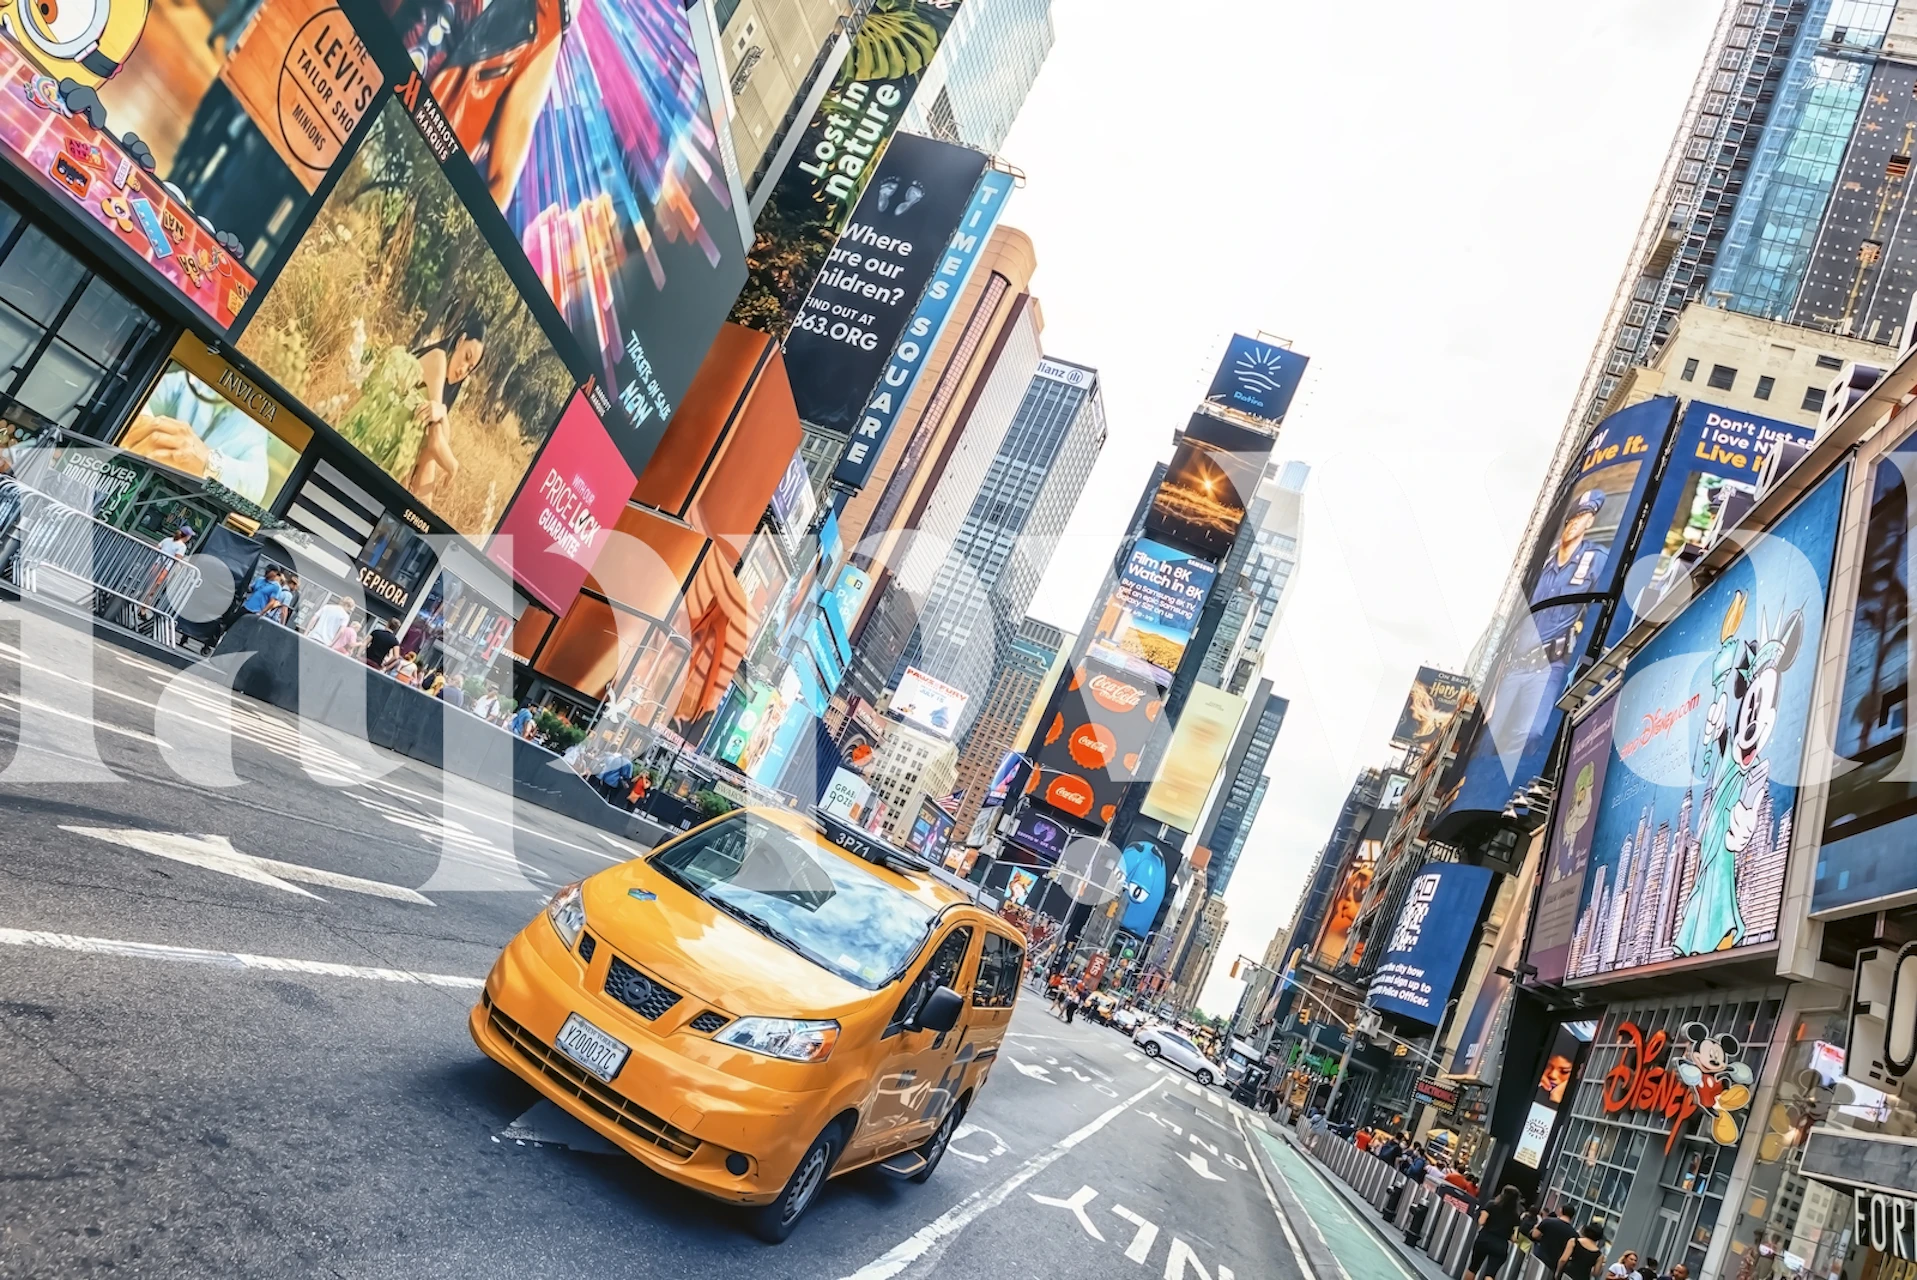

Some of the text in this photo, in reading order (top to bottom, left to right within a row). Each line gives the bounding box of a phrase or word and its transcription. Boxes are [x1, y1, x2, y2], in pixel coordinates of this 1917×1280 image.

[349, 32, 371, 66] THE
[297, 48, 333, 104] TAILOR
[314, 24, 372, 112] LEVI'S
[291, 104, 326, 152] MINIONS
[416, 111, 449, 161] MARQUIS
[423, 98, 460, 155] MARRIOTT
[798, 82, 870, 179] Lost in
[825, 84, 901, 201] nature
[841, 222, 913, 257] Where
[927, 185, 999, 300] TIMES
[828, 247, 905, 279] are our
[805, 296, 876, 326] FIND OUT AT
[625, 329, 671, 421] TICKETS ON SALE
[846, 317, 932, 465] SQUARE
[217, 368, 279, 423] INVICTA
[618, 379, 654, 429] NOW
[1701, 427, 1709, 439] I
[1711, 429, 1750, 449] love
[1706, 413, 1756, 436] Don't
[1756, 426, 1793, 442] just
[69, 453, 137, 483] DISCOVER
[1581, 435, 1649, 473] Live it.
[1695, 441, 1747, 468] Live
[403, 508, 430, 534] SEPHORA
[539, 468, 602, 548] PRICE LOCK
[538, 508, 580, 559] GUARANTEE
[1128, 563, 1205, 601] Watch in 8K
[1132, 551, 1193, 582] Film in 8K
[1187, 559, 1215, 574] SAMSUNG
[356, 567, 410, 608] SEPHORA
[1121, 578, 1137, 589] Buy
[1141, 585, 1176, 604] Samsung
[1159, 600, 1193, 620] Samsung
[907, 669, 967, 701] PAWS FURY
[1089, 674, 1146, 706] Coca-Cola
[1429, 681, 1459, 699] Harry
[1438, 672, 1450, 680] ON
[1078, 736, 1108, 754] Coca-Cola
[1055, 787, 1086, 805] Coca-Cola
[836, 832, 870, 859] 3P71
[1406, 965, 1426, 978] how
[1408, 980, 1420, 991] up
[1420, 982, 1432, 994] to
[1398, 990, 1430, 1008] Officer.
[564, 1025, 617, 1070] Y200037C
[1603, 1021, 1698, 1157] Disney
[1854, 1188, 1917, 1264] FOR
